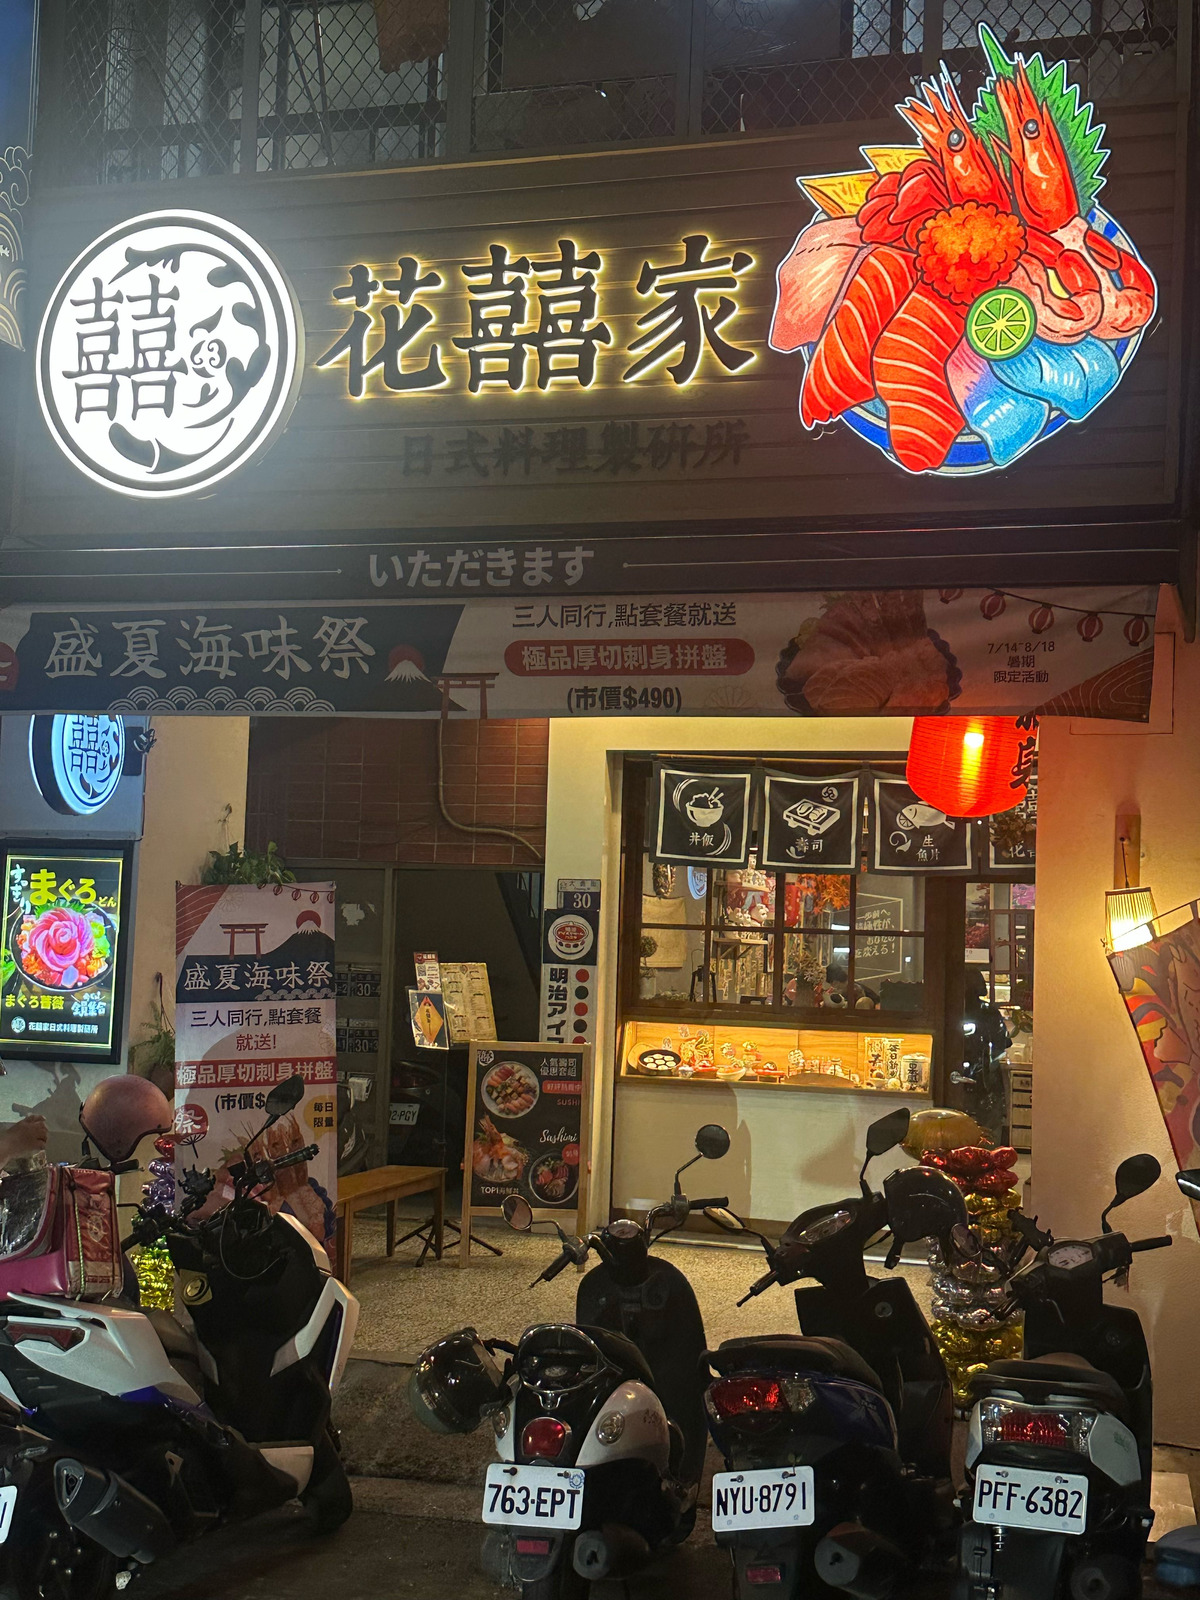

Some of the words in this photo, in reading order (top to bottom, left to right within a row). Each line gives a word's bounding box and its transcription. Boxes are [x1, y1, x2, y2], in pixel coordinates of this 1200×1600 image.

[368, 546, 594, 588] いただきます
[45, 615, 376, 680] 盛夏海味祭
[521, 644, 728, 672] 極品厚切刺身拼盤
[1007, 655, 1036, 669] 暑期
[993, 670, 1050, 684] 限定活動
[567, 686, 682, 714] (市價$490)
[29, 868, 97, 906] まぐろ
[573, 892, 592, 909] 30
[183, 960, 333, 992] 盛夏海味祭
[177, 1060, 334, 1086] 極品厚切刺身拼盤
[313, 1116, 334, 1129] 限量
[389, 1109, 417, 1122] 2-PGY
[488, 1483, 581, 1519] 763-EPT
[716, 1481, 807, 1517] NYU-8791
[978, 1479, 1084, 1519] PFF-6382
